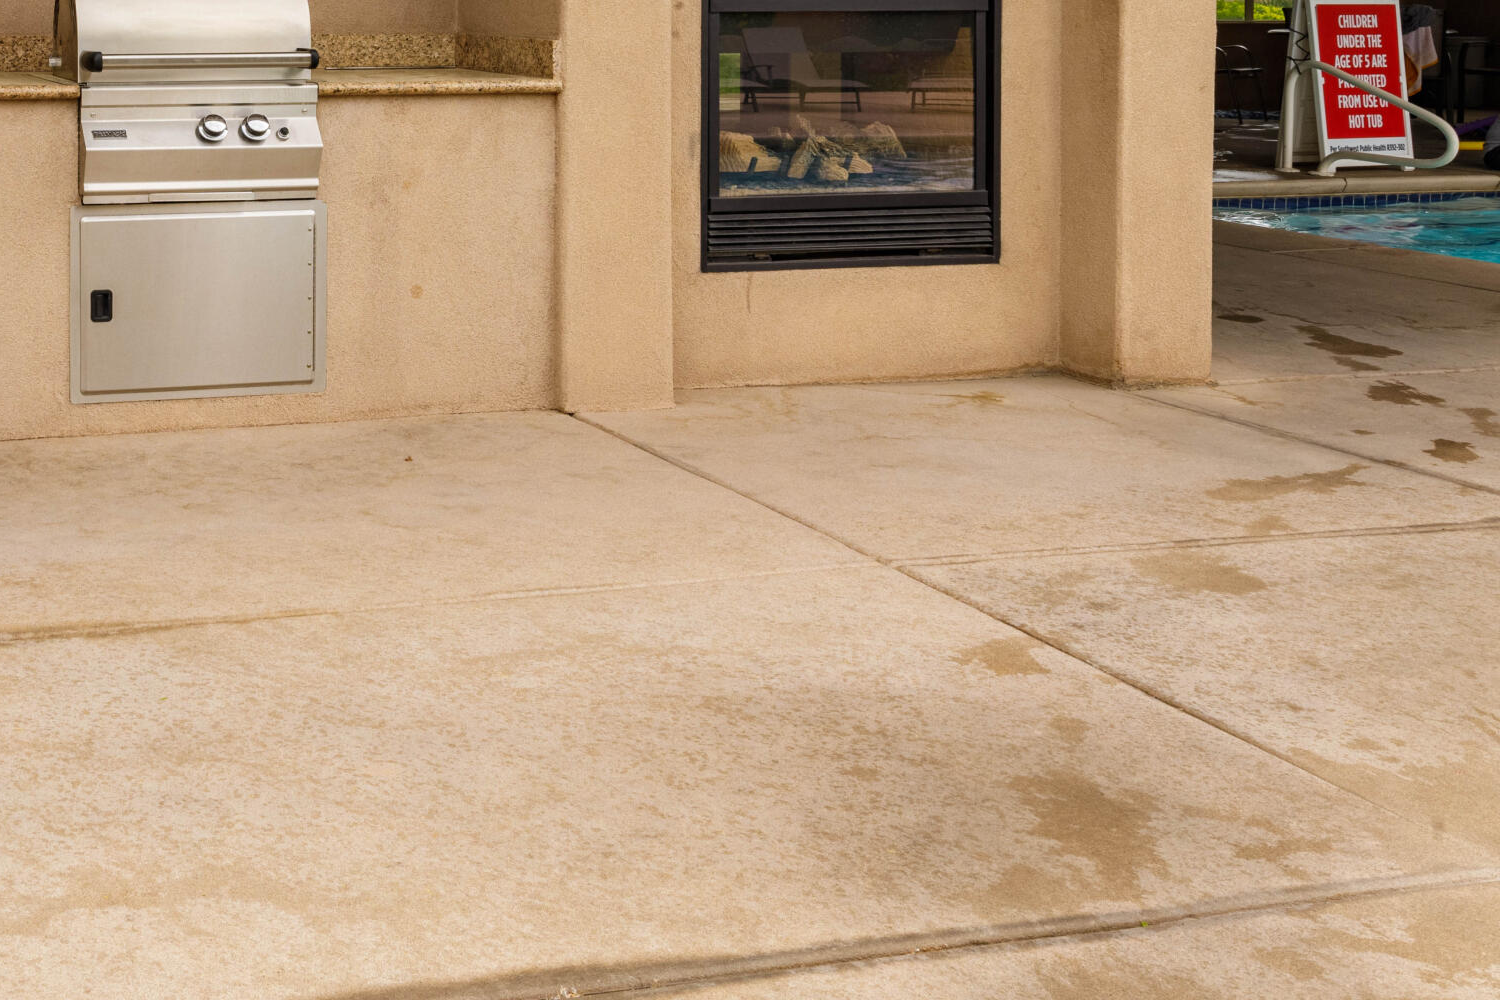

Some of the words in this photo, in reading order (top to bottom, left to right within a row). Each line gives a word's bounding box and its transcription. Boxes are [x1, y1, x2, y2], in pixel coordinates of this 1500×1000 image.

[1338, 14, 1378, 29] CHILDREN
[1336, 34, 1365, 49] UNDER
[1366, 34, 1382, 48] THE
[1334, 55, 1351, 69] AGE
[1352, 55, 1363, 69] OF
[1364, 54, 1371, 68] 5
[1371, 54, 1387, 68] ARE
[1338, 94, 1361, 109] FROM
[1362, 94, 1379, 109] USE
[1349, 114, 1365, 129] HOT
[1366, 114, 1384, 128] TUB
[1359, 144, 1372, 152] Public
